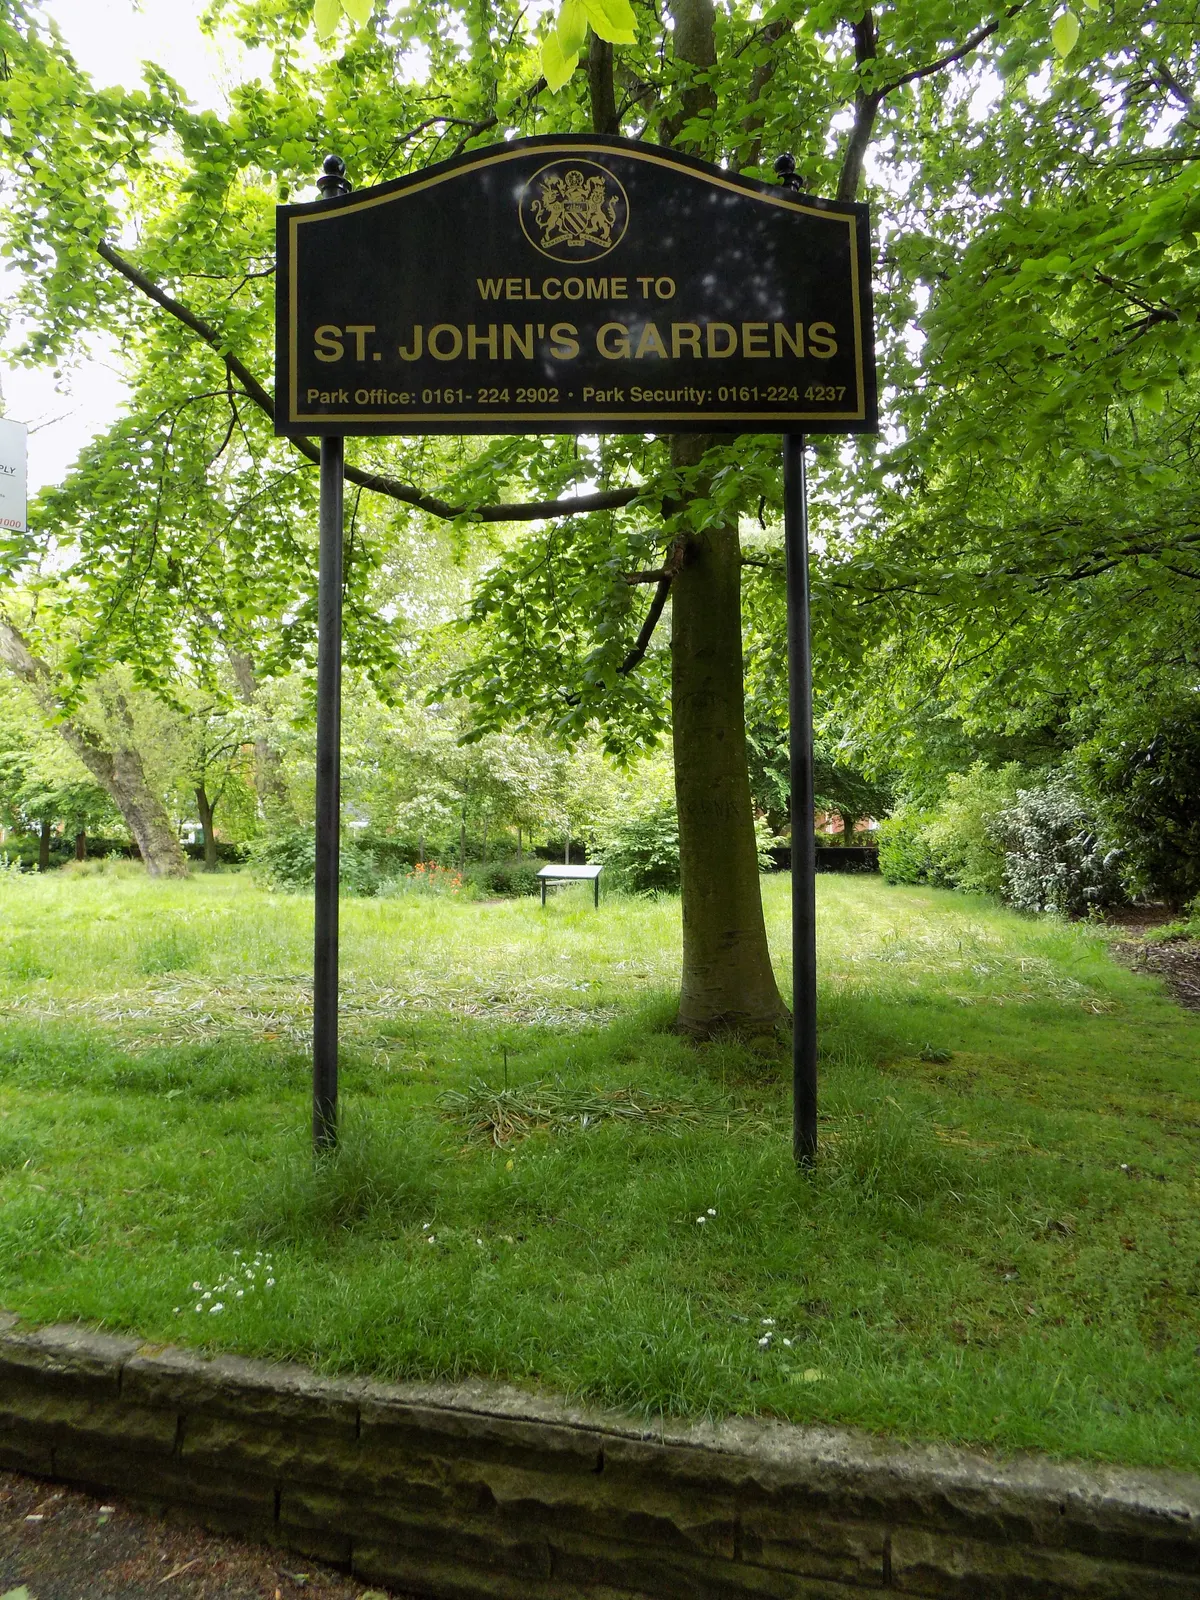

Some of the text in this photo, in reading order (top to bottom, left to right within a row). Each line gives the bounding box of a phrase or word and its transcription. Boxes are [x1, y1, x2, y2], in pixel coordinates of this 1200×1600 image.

[476, 276, 676, 300] WELCOME TO
[313, 321, 838, 363] ST. JOHN'S GARDENS
[306, 385, 847, 405] Park Office: 0161- 224 2902 Park Security: 0161-224 4237
